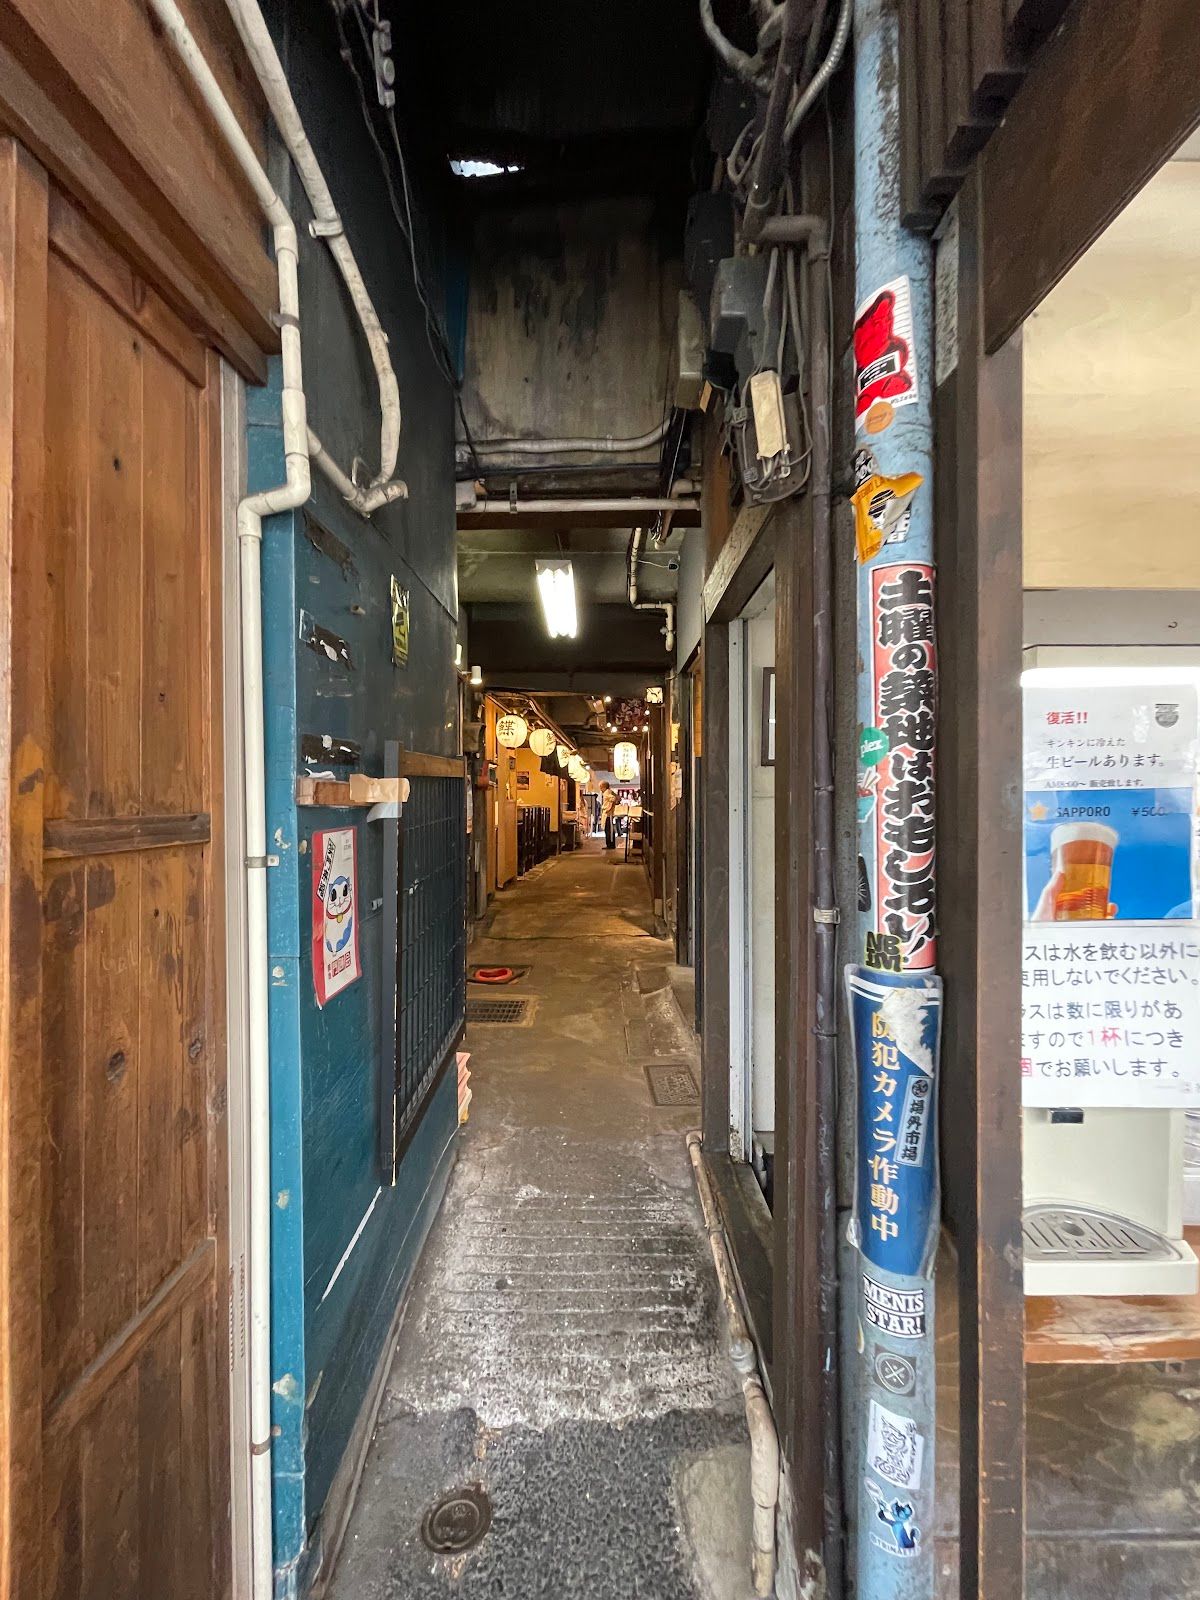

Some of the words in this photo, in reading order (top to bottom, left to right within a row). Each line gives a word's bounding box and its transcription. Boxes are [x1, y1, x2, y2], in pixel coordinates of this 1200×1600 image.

[1046, 711, 1088, 725] 復活!!
[1046, 737, 1126, 748] キンキンに冷えた
[1046, 753, 1165, 770] 生ビールあります。
[1057, 806, 1111, 818] SAPPORO
[1022, 1000, 1183, 1020] スは数に限りがあ
[1021, 1027, 1184, 1048] すので1杯につき
[866, 1303, 922, 1335] STAR!
